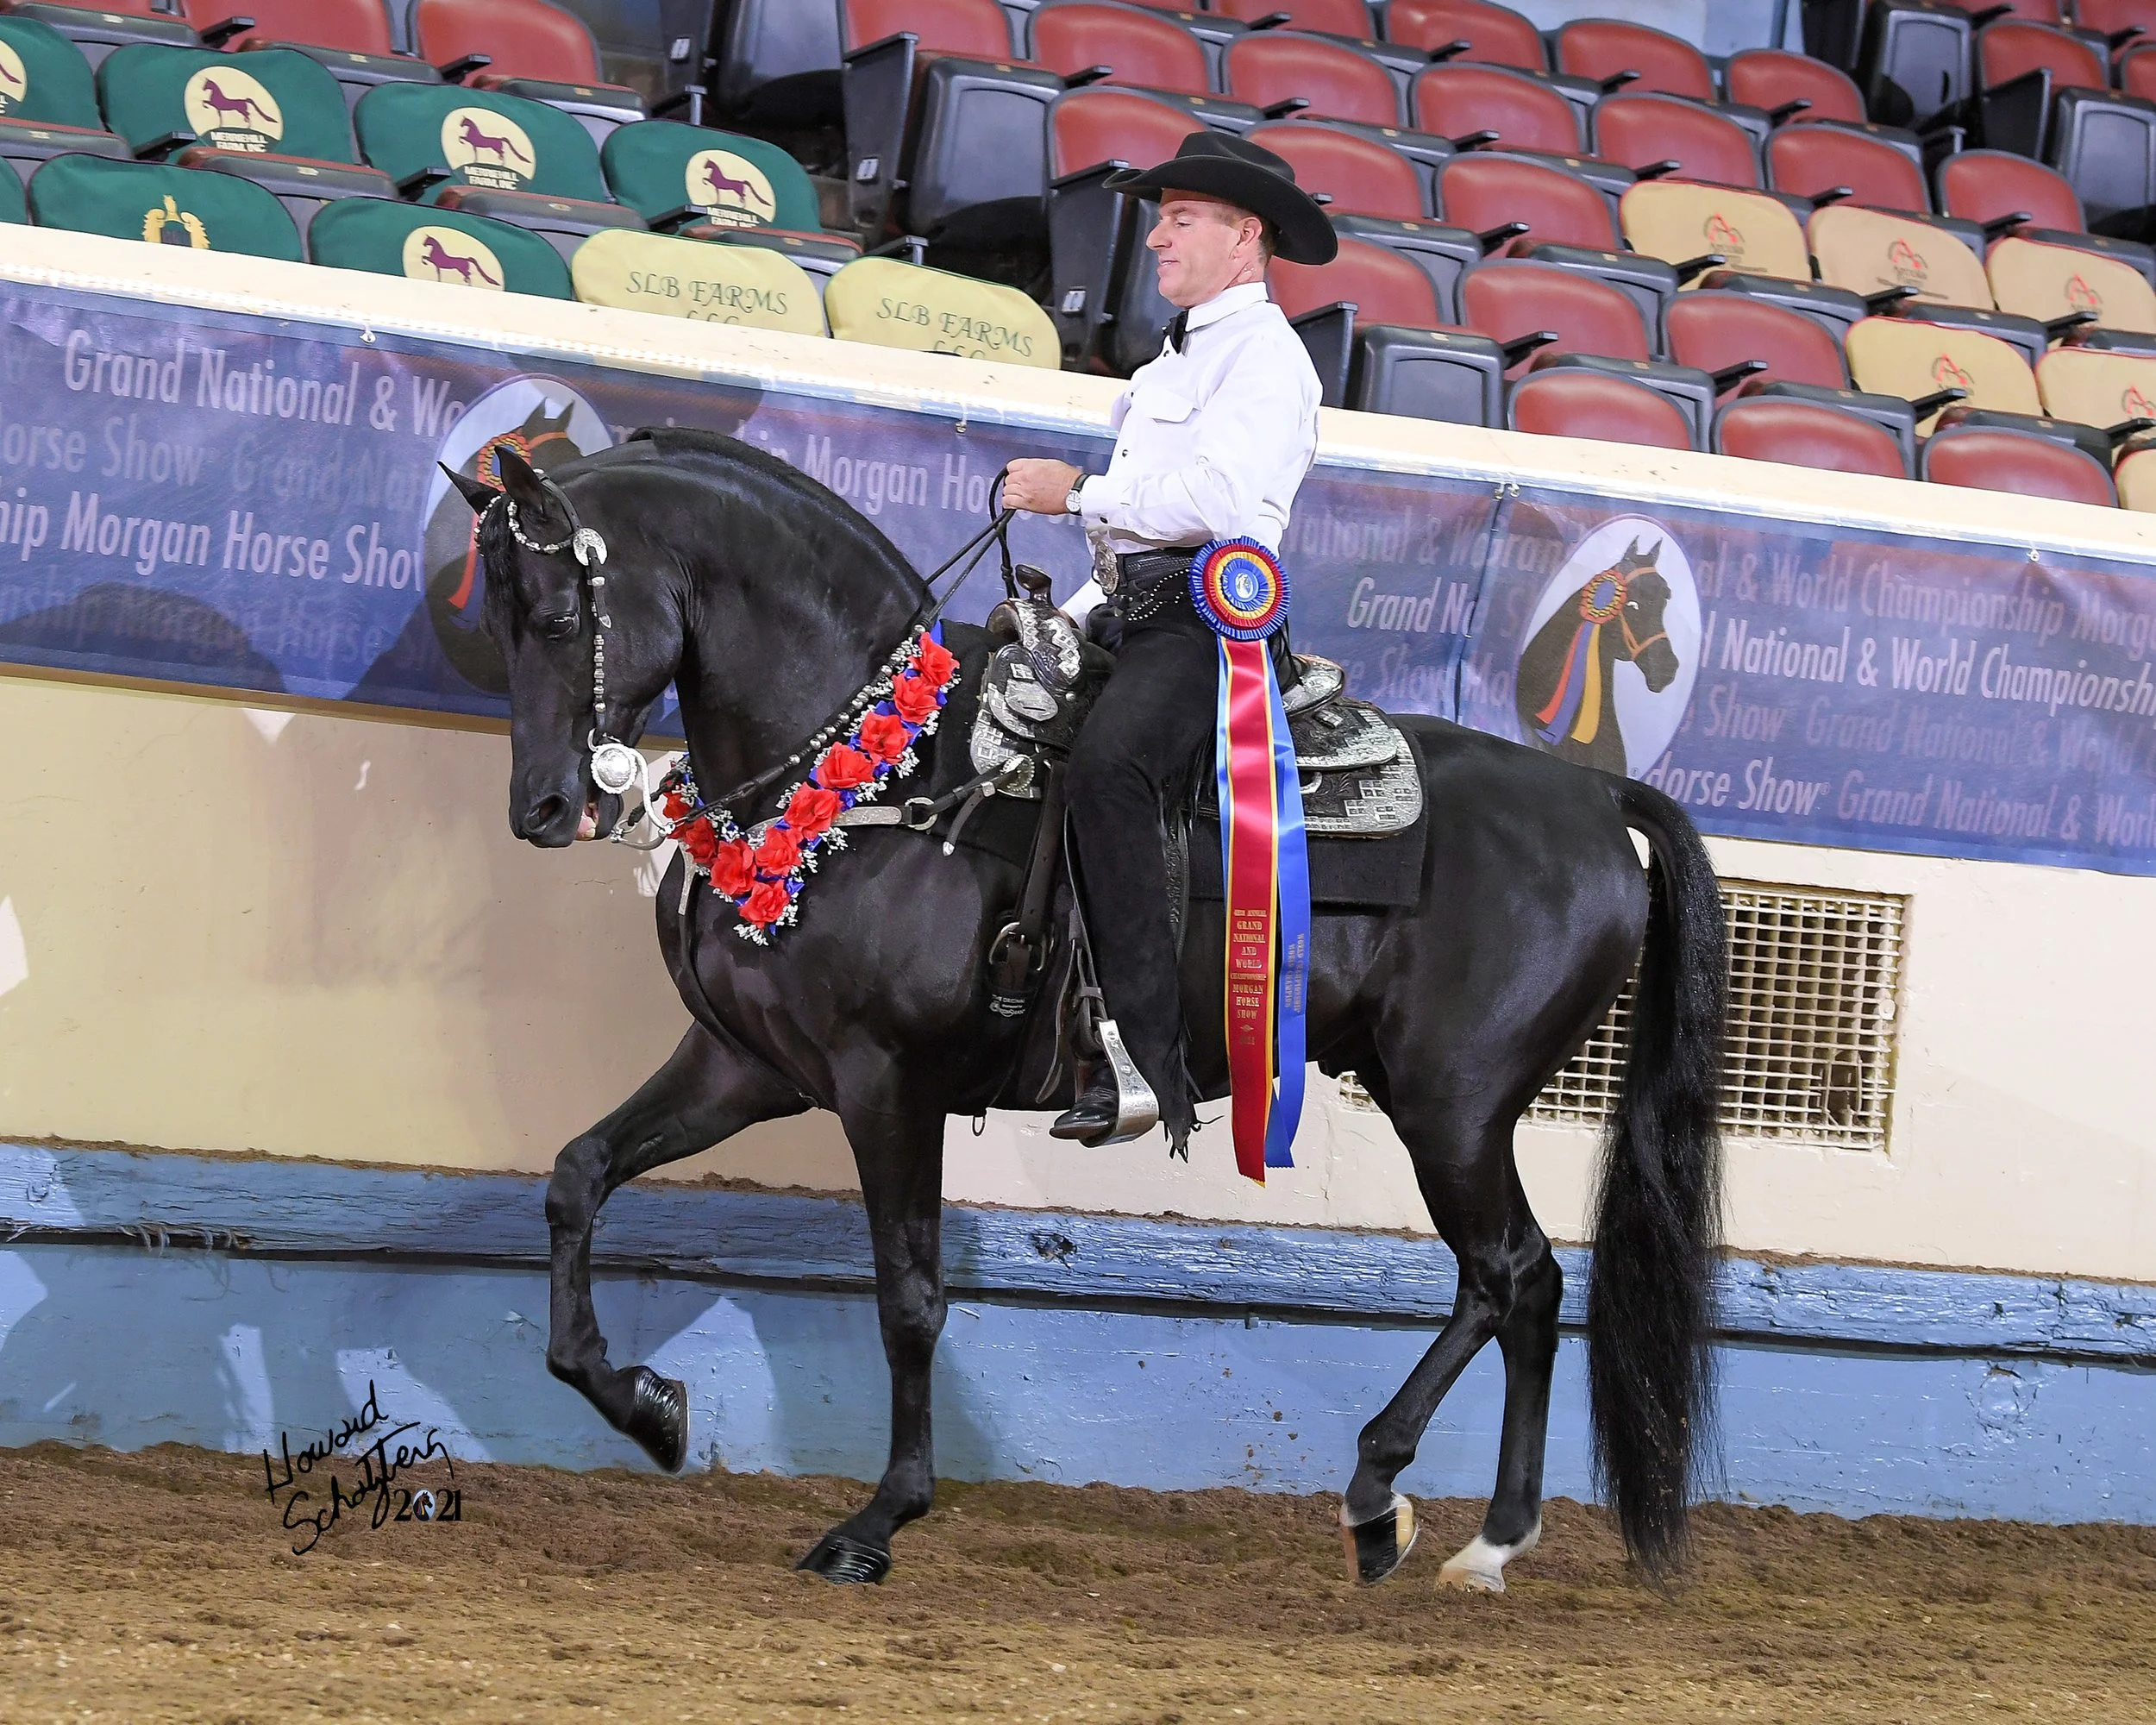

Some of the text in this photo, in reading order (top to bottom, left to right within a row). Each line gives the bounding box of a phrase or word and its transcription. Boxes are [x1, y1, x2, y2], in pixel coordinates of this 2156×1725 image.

[626, 271, 788, 315] SLB FARMS
[876, 298, 931, 326] SLB
[937, 312, 1032, 357] FARMS
[65, 329, 185, 404] Grand
[197, 346, 359, 426] National
[369, 376, 398, 432] &
[60, 490, 211, 576] Morgan
[222, 510, 330, 580] Horse
[1348, 575, 1443, 637] Grand
[1773, 553, 1855, 614] World
[1861, 559, 2064, 647] Championship
[1720, 616, 1852, 684] National
[1857, 636, 1879, 688] &
[1892, 636, 1977, 696] World
[1837, 768, 1934, 827] Grand
[1934, 778, 2059, 838] National
[2059, 794, 2084, 840] &
[1233, 933, 1266, 944] NATIONAL
[1237, 920, 1263, 931] GRAND
[1235, 958, 1263, 969] WORLD
[1241, 946, 1257, 956] AND
[1232, 983, 1264, 994] MORGAN
[1236, 996, 1260, 1007] HORSE
[1237, 1009, 1258, 1019] SHOW
